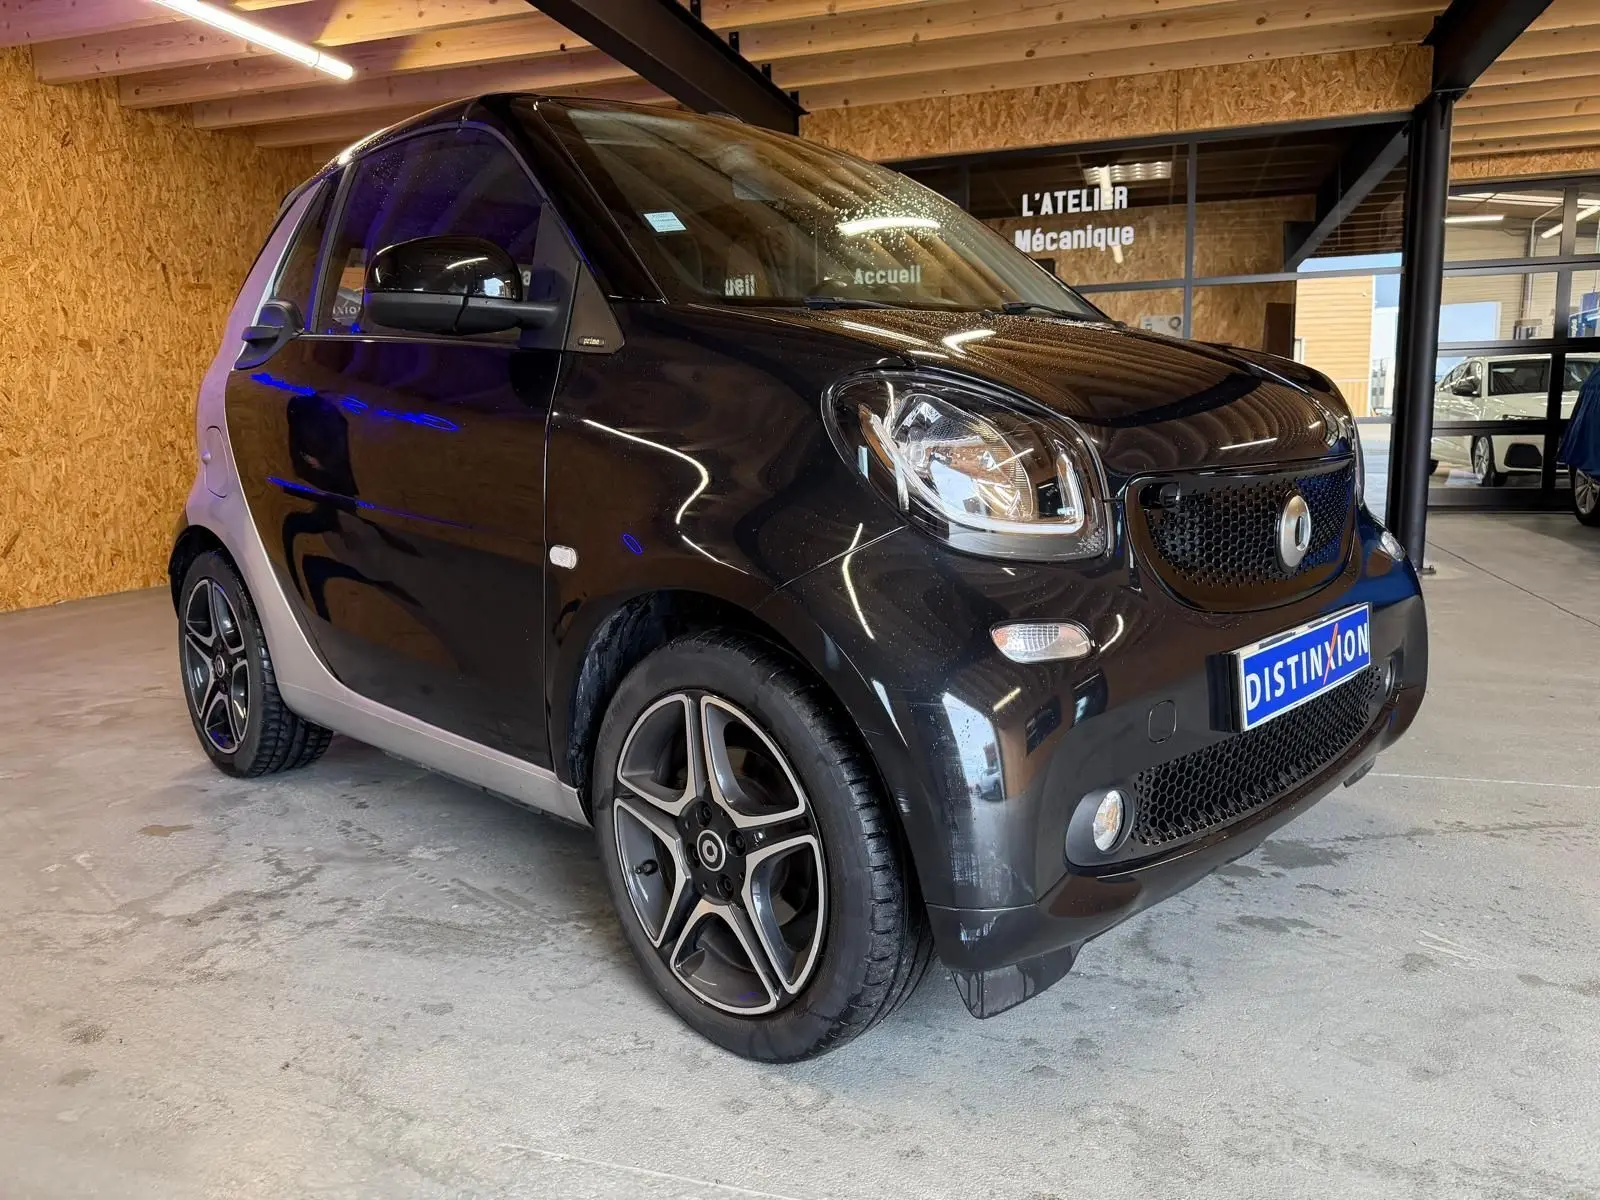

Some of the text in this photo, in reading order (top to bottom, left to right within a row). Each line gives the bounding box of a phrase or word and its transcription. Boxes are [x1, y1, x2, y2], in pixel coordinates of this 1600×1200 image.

[1014, 224, 1135, 252] Mécanique
[854, 264, 921, 285] Accueil
[1245, 622, 1369, 711] DISTINXION
